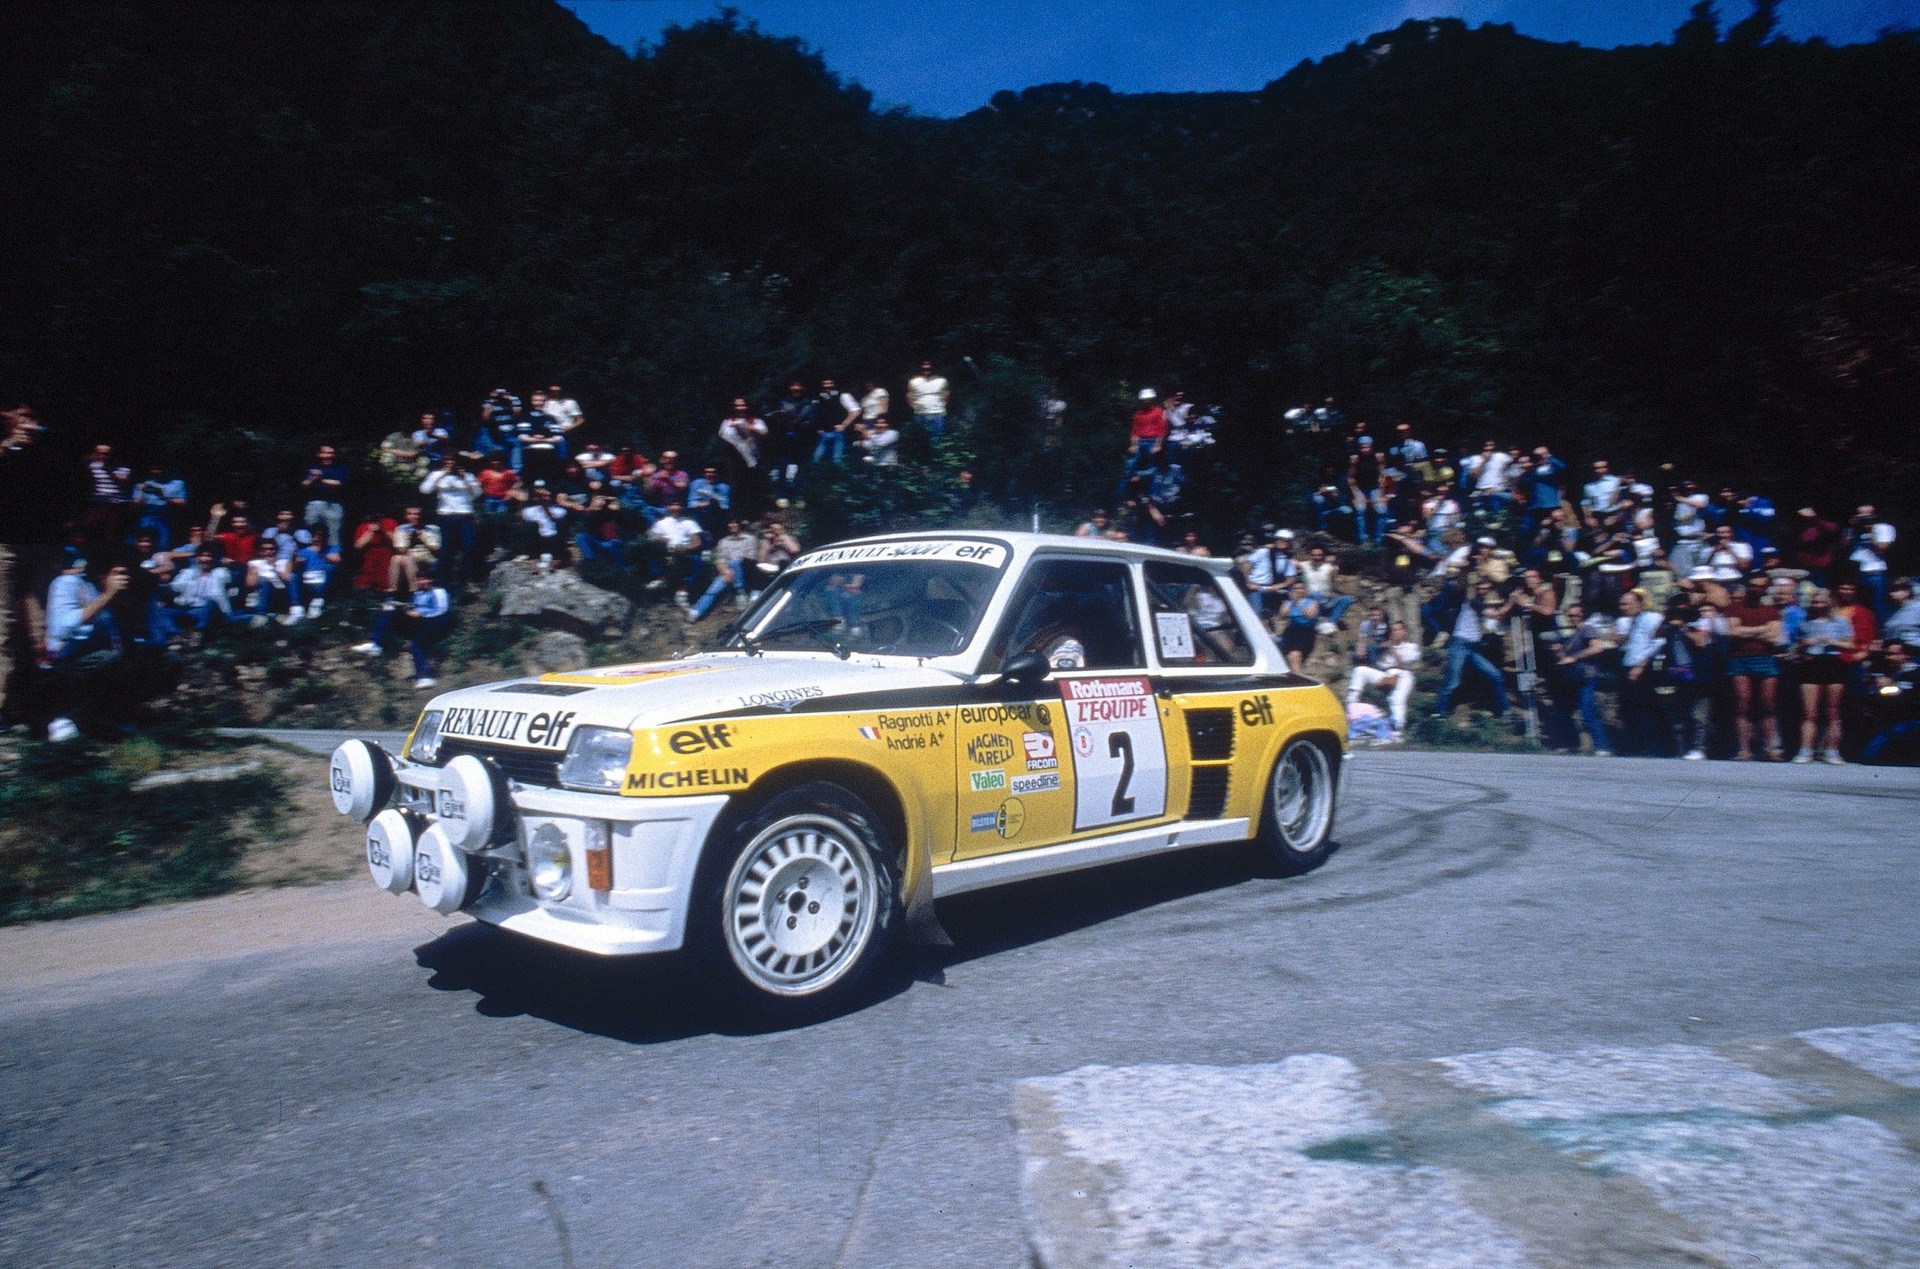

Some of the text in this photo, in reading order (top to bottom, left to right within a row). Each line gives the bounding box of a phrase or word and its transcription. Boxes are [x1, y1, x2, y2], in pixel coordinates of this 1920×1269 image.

[815, 546, 890, 563] RENAULT
[955, 545, 994, 560] elf
[739, 685, 823, 707] LONGINES
[1069, 679, 1145, 698] Rothmans
[961, 705, 1031, 725] europcar
[1077, 698, 1147, 722] L'EQUIPE
[1240, 695, 1274, 726] elf
[439, 707, 577, 747] RENAULT elf
[878, 712, 933, 731] Ragnotti
[670, 723, 733, 754] elf
[886, 734, 926, 751] Andrié
[628, 768, 749, 790] MICHELIN
[971, 770, 1005, 790] Valeo
[1012, 775, 1059, 792] speedline
[1108, 730, 1136, 817] 2
